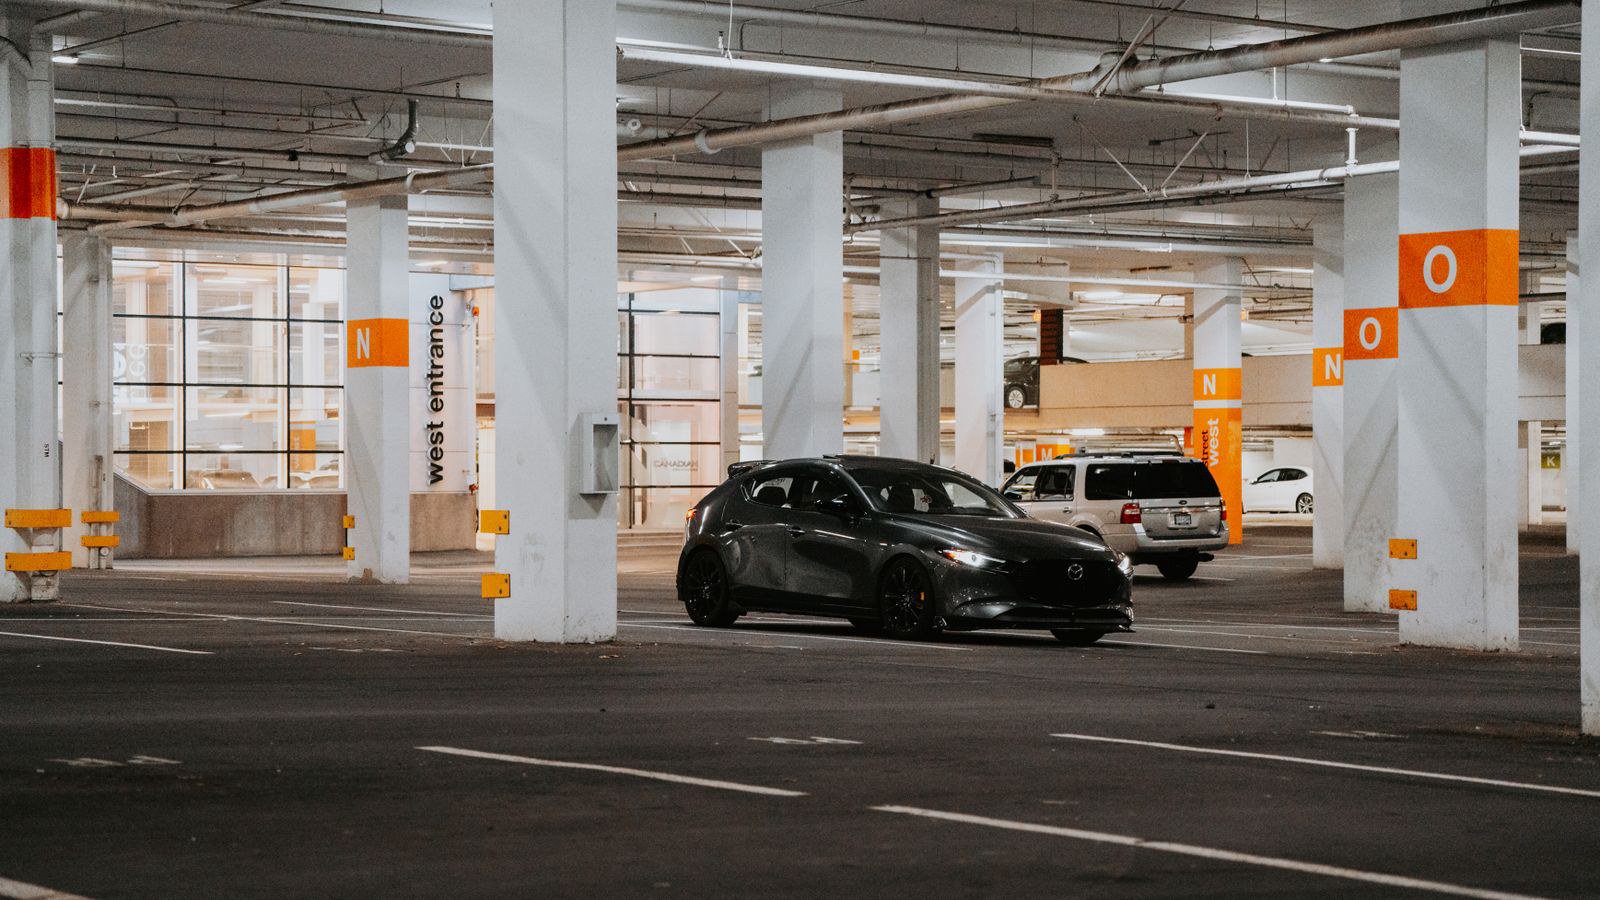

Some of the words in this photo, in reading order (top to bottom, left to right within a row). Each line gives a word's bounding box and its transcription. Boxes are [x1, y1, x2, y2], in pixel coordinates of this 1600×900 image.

[1423, 245, 1457, 293] O
[356, 327, 370, 359] N
[1359, 317, 1382, 350] O
[426, 295, 444, 413] entrance
[1325, 354, 1341, 380] N
[1203, 374, 1216, 395] N
[426, 420, 444, 486] west
[1041, 447, 1053, 461] M
[1209, 418, 1219, 466] west
[1546, 456, 1556, 467] K
